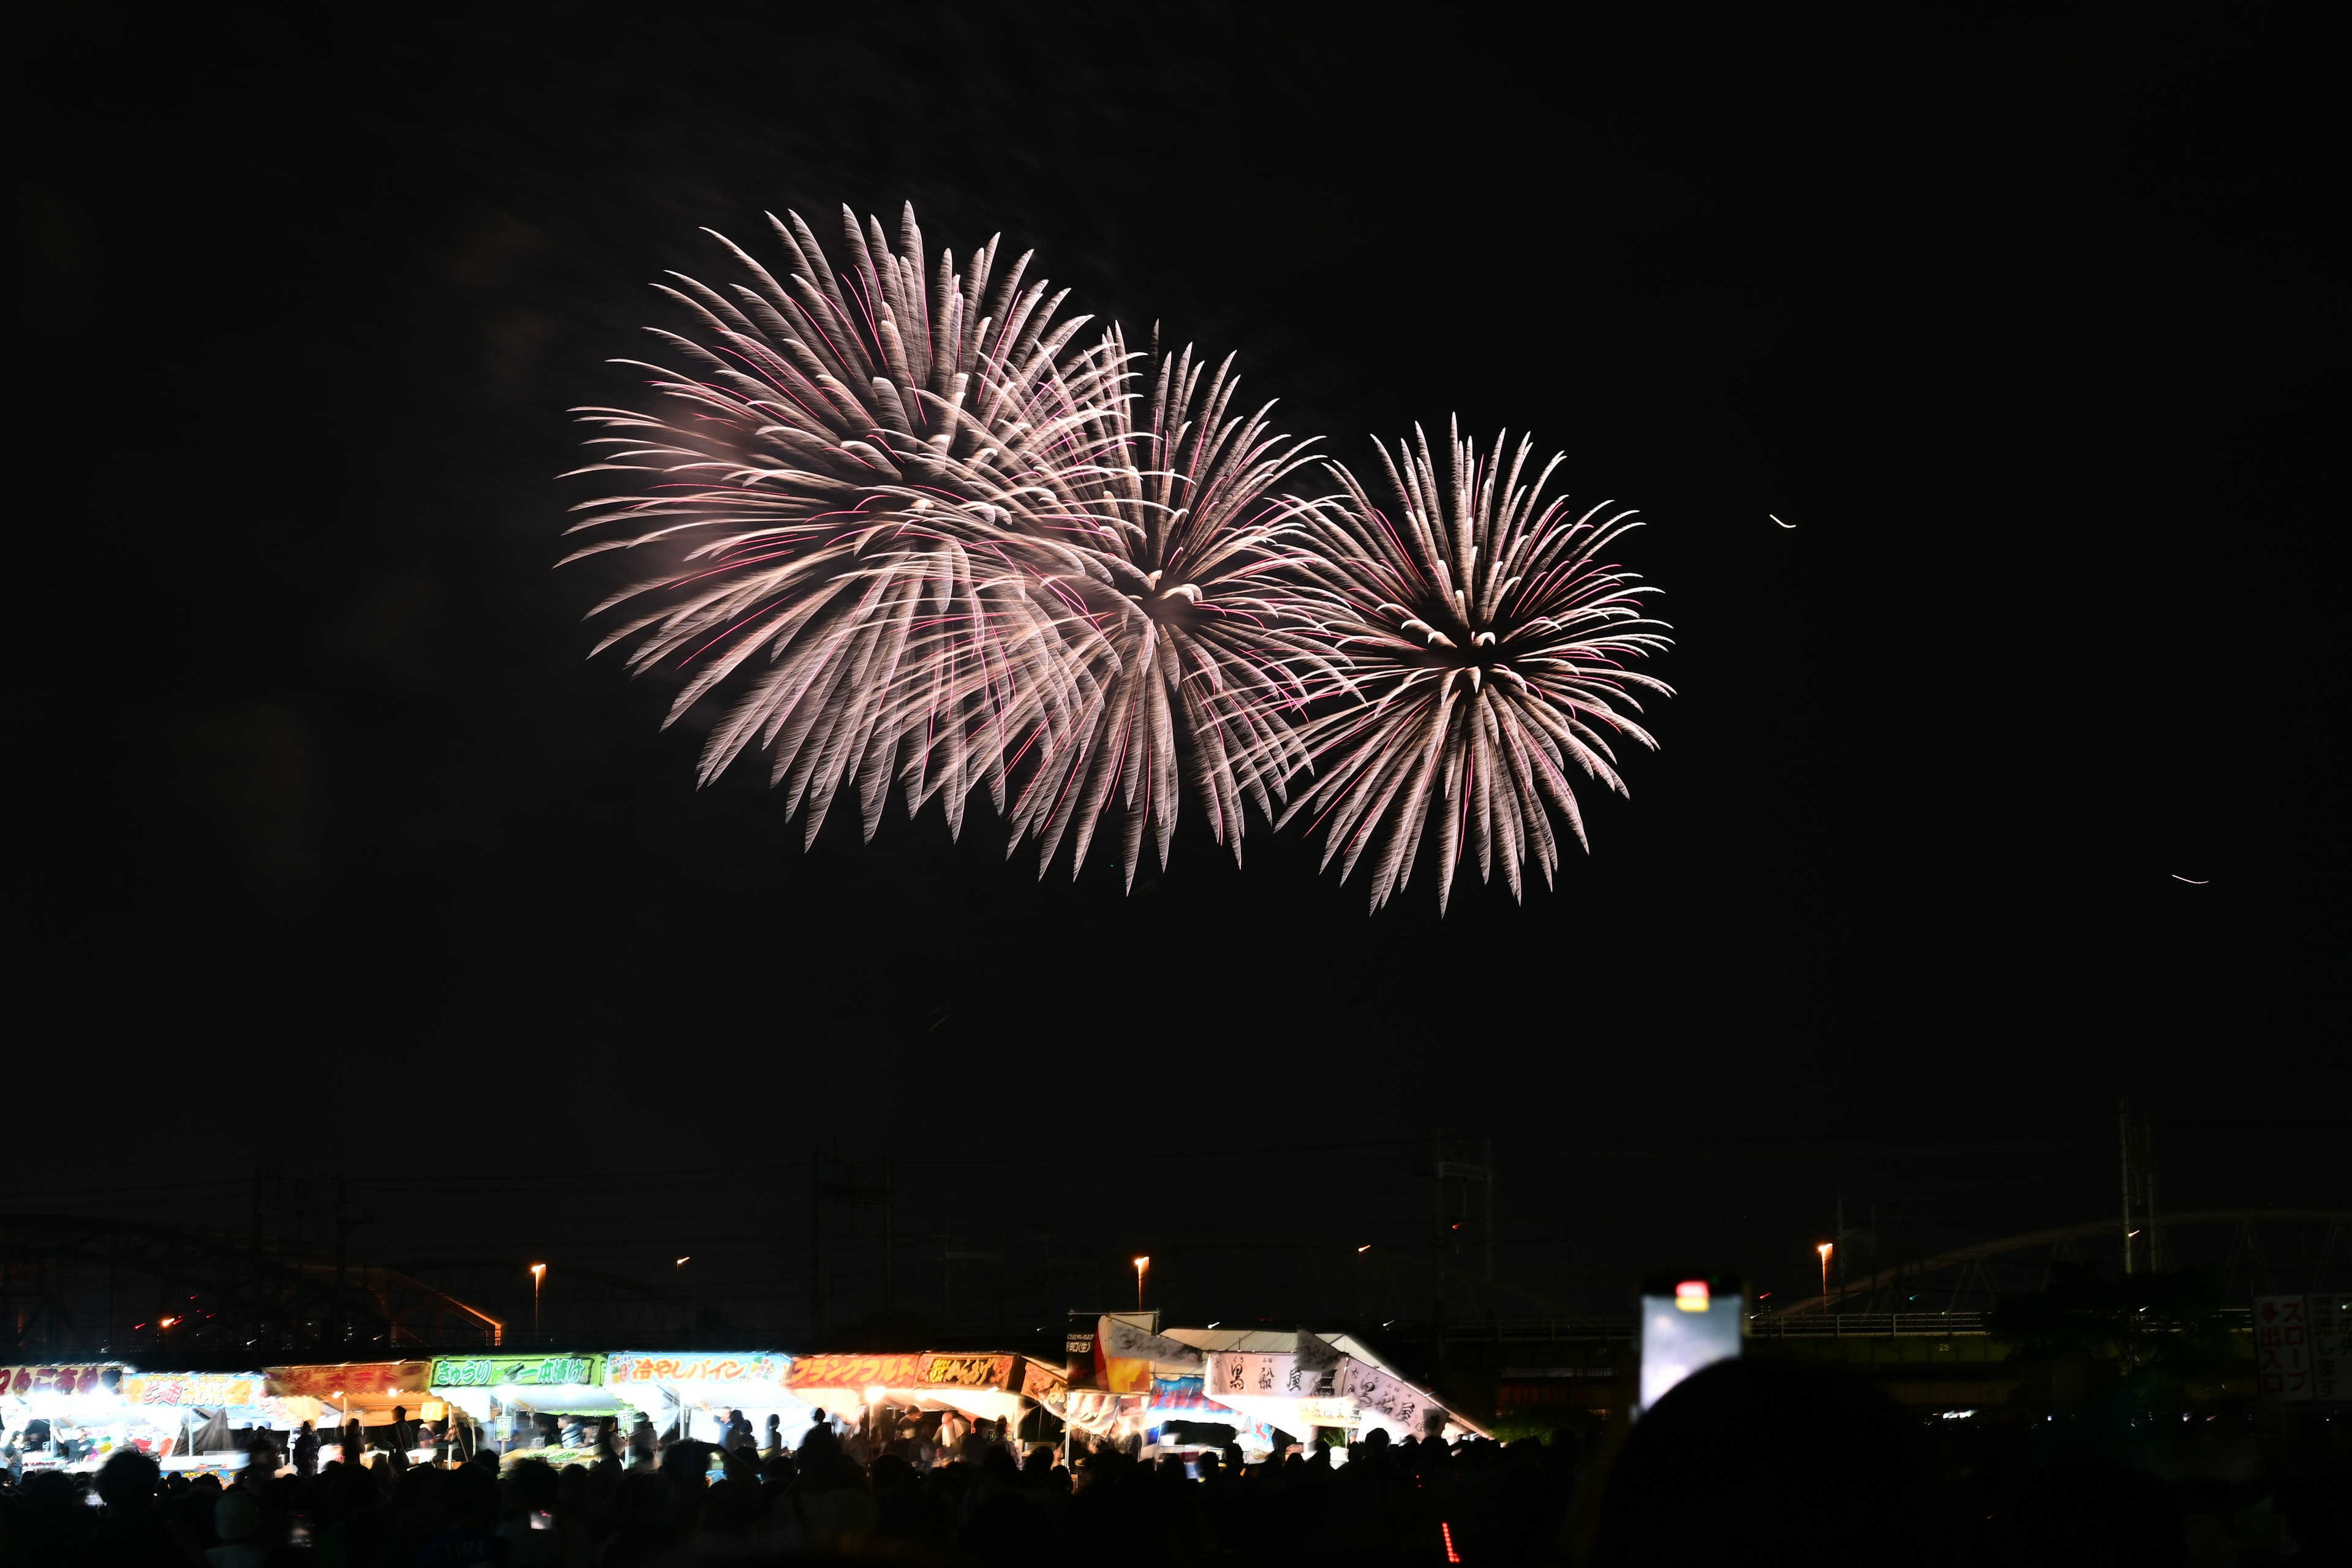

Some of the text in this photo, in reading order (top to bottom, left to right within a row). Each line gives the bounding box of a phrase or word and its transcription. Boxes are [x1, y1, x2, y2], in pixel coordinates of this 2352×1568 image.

[2260, 1327, 2285, 1393] 出入口
[2282, 1303, 2308, 1392] スロープ
[437, 1360, 492, 1385] きゅうり
[519, 1359, 584, 1384] 一本漬け
[630, 1357, 749, 1384] 冷やしパイン
[793, 1357, 915, 1383] フランクフルト
